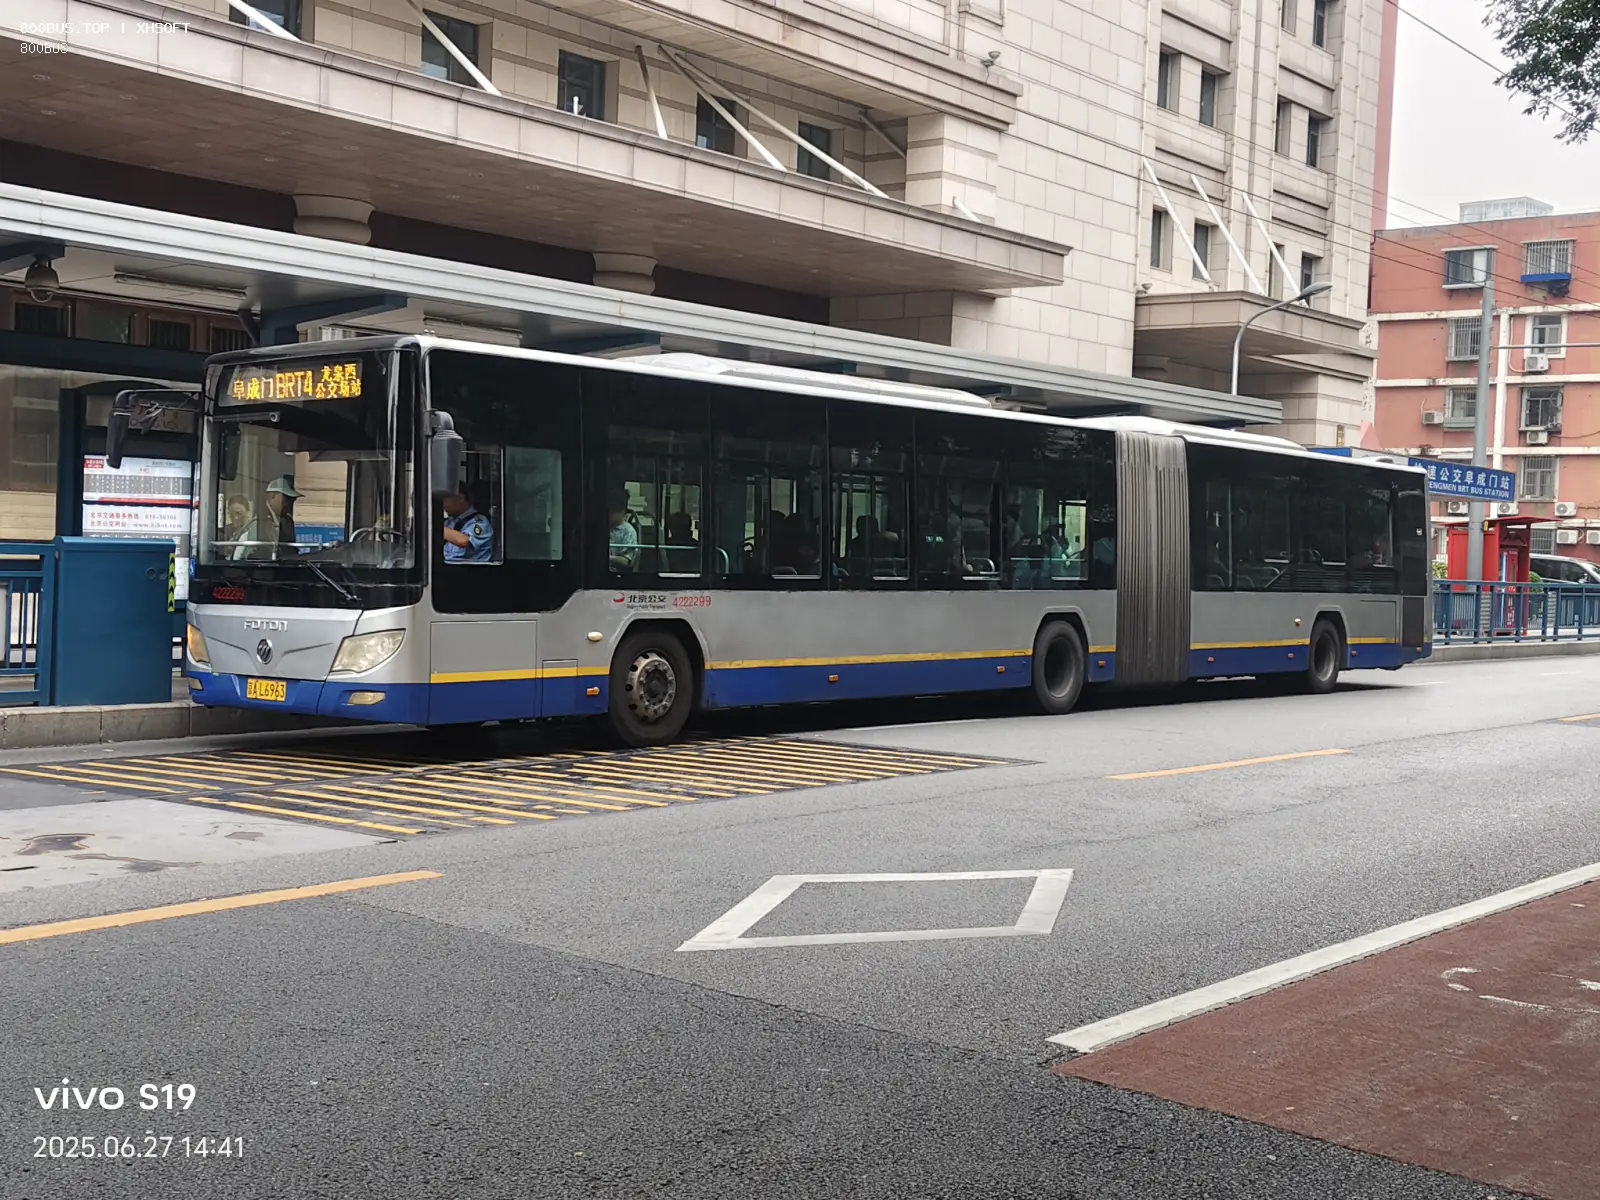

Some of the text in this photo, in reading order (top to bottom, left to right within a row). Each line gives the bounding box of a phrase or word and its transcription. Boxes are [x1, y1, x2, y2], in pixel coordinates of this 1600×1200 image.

[321, 363, 357, 382] 龙泉西
[232, 370, 313, 400] 阜成门 BRT4
[316, 379, 362, 398] 公交场站
[1428, 481, 1510, 498] ENGMEN BRT BUS STATION
[627, 594, 667, 603] 北京公交
[672, 595, 712, 608] 4222299
[243, 619, 289, 632] FOTON
